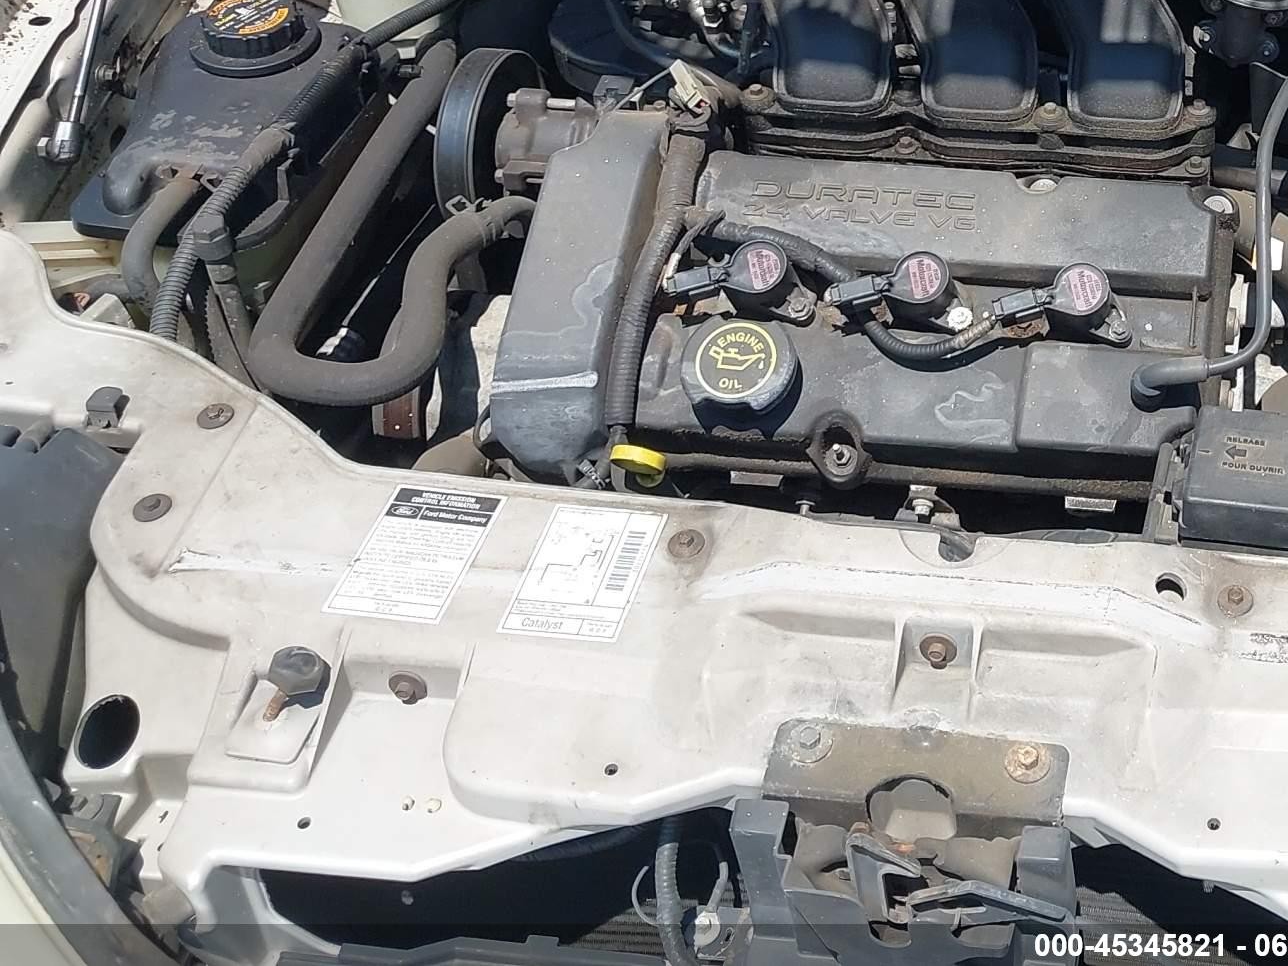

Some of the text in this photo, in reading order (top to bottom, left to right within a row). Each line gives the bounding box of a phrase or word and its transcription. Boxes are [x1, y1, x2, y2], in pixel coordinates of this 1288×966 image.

[751, 180, 976, 210] DURATEC
[743, 203, 790, 218] 24
[802, 205, 917, 226] VALVE
[716, 332, 765, 353] ENGINE
[719, 378, 743, 389] OIL
[1225, 436, 1266, 447] RELEASE
[1221, 461, 1284, 474] POUR OUVRIR
[411, 496, 481, 509] CONTROL INFORMATION
[422, 492, 477, 503] VEHICLE EMISSION
[423, 510, 488, 524] Ford Motor Company
[521, 617, 563, 630] Catalyst
